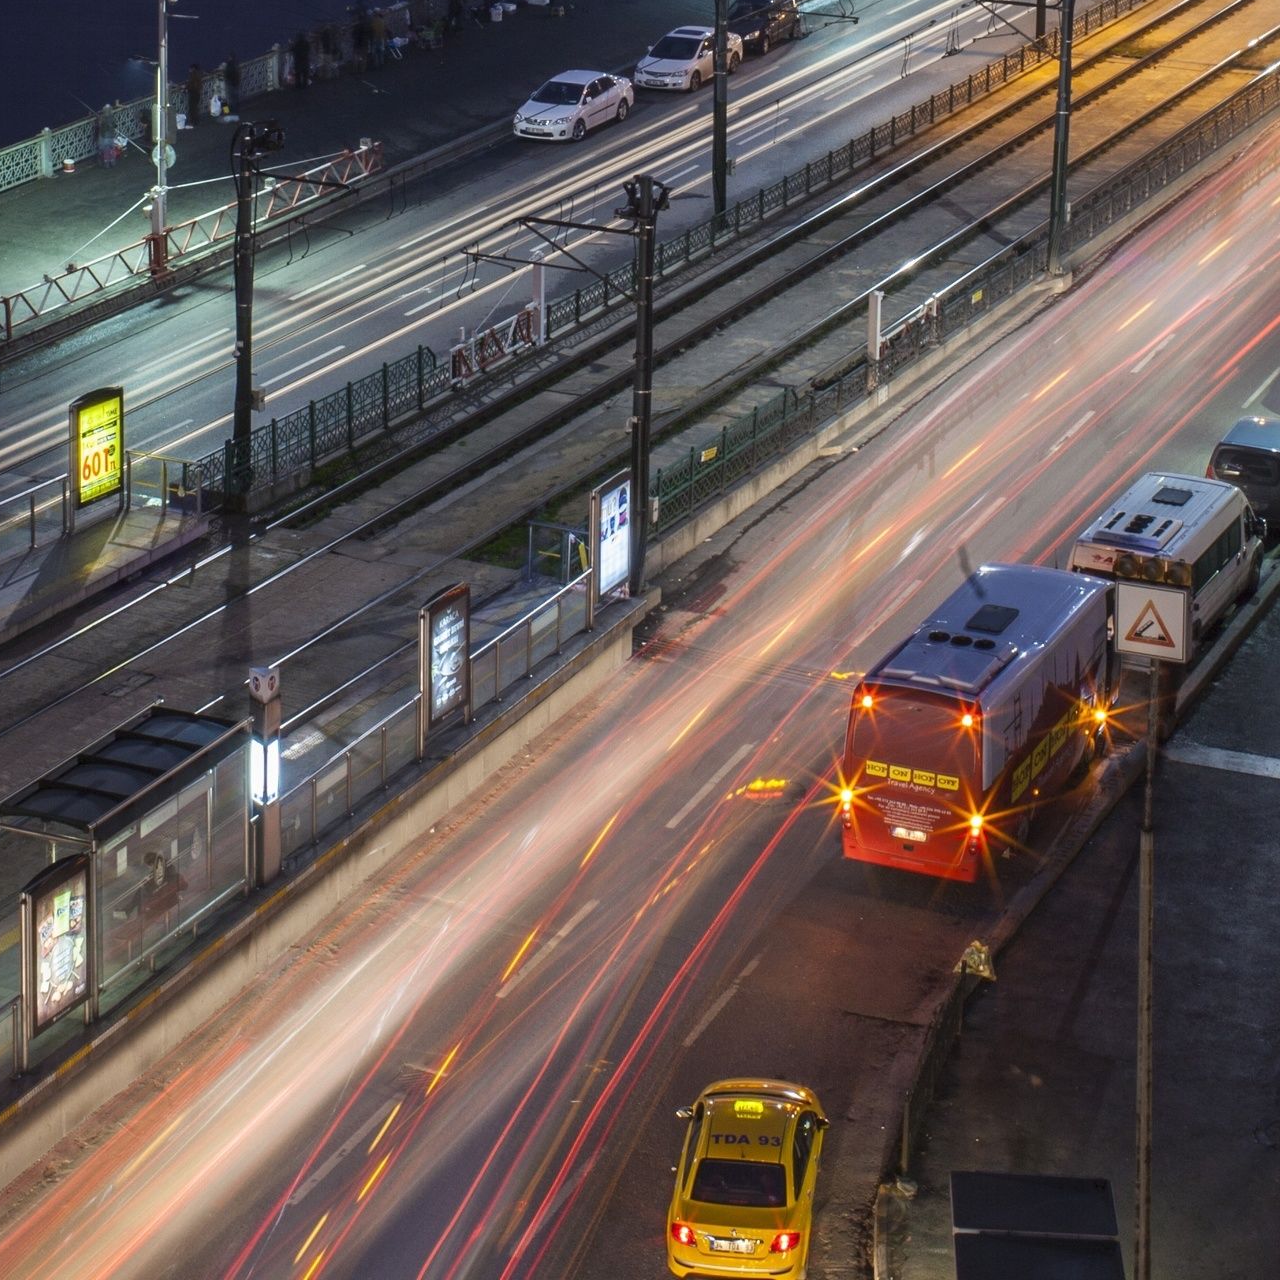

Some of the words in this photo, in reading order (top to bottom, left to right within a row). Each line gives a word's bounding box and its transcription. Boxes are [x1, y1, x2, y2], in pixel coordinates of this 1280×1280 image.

[892, 768, 908, 777] ON
[887, 778, 908, 789] Travel
[909, 783, 936, 795] Agency
[712, 1134, 751, 1145] TDA
[758, 1135, 782, 1147] 93
